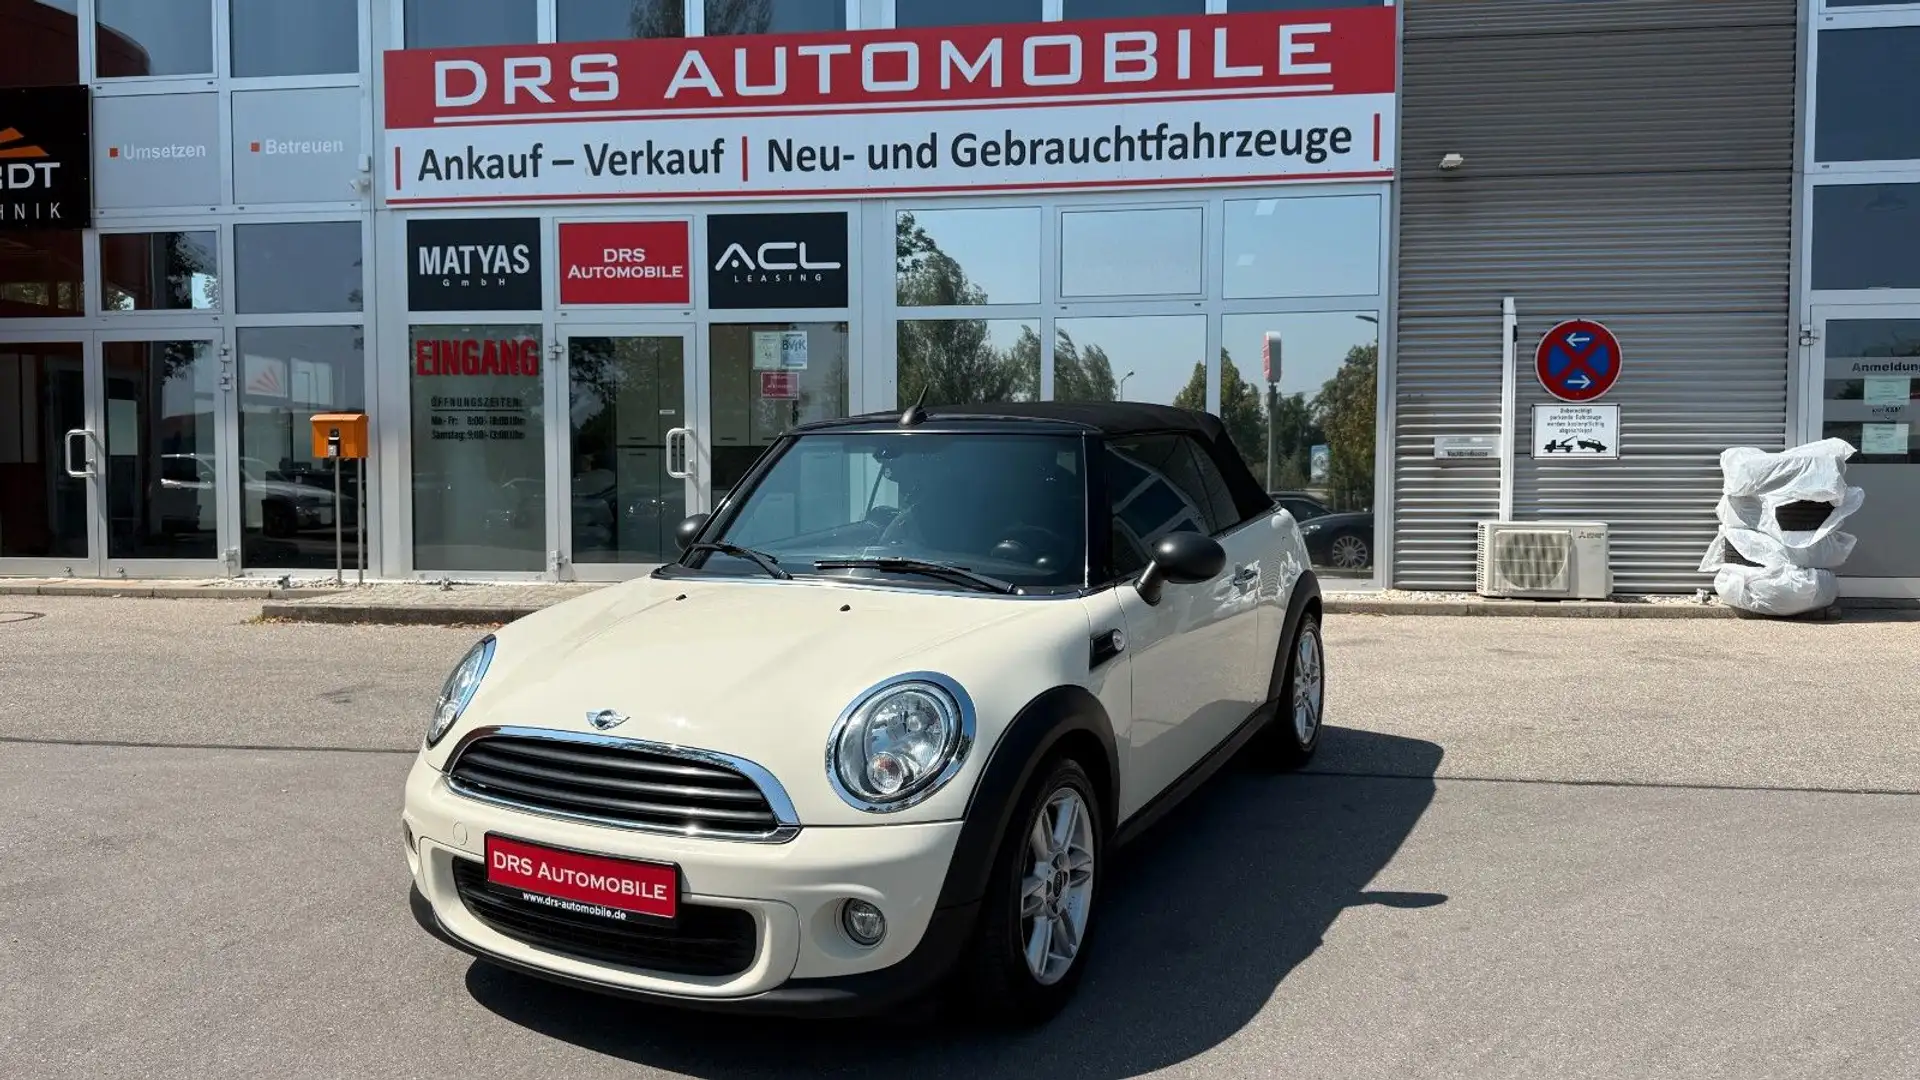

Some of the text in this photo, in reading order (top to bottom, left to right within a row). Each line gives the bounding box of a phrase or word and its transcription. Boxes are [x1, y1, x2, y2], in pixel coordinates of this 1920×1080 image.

[434, 23, 1331, 107] DRS AUTOMOBILE
[123, 143, 206, 160] Umsetzen
[264, 139, 344, 155] Betreuen
[417, 142, 543, 182] Ankauf
[583, 137, 725, 177] Verkauf
[768, 137, 855, 173] Neu-
[868, 132, 937, 169] und
[951, 121, 1352, 168] Gebrauchtfahrzeuge
[0, 162, 61, 189] DT
[418, 243, 531, 276] MATYAS
[603, 247, 646, 263] DRS
[715, 241, 841, 271] ACL
[567, 262, 684, 279] AUTOMOBILE
[734, 273, 822, 283] LEASING
[416, 337, 539, 377] EINGANG
[1852, 362, 1920, 375] Anmeldun
[493, 851, 668, 900] DRS AUTOMOBILE
[522, 892, 627, 920] www.drs-automobile.de
